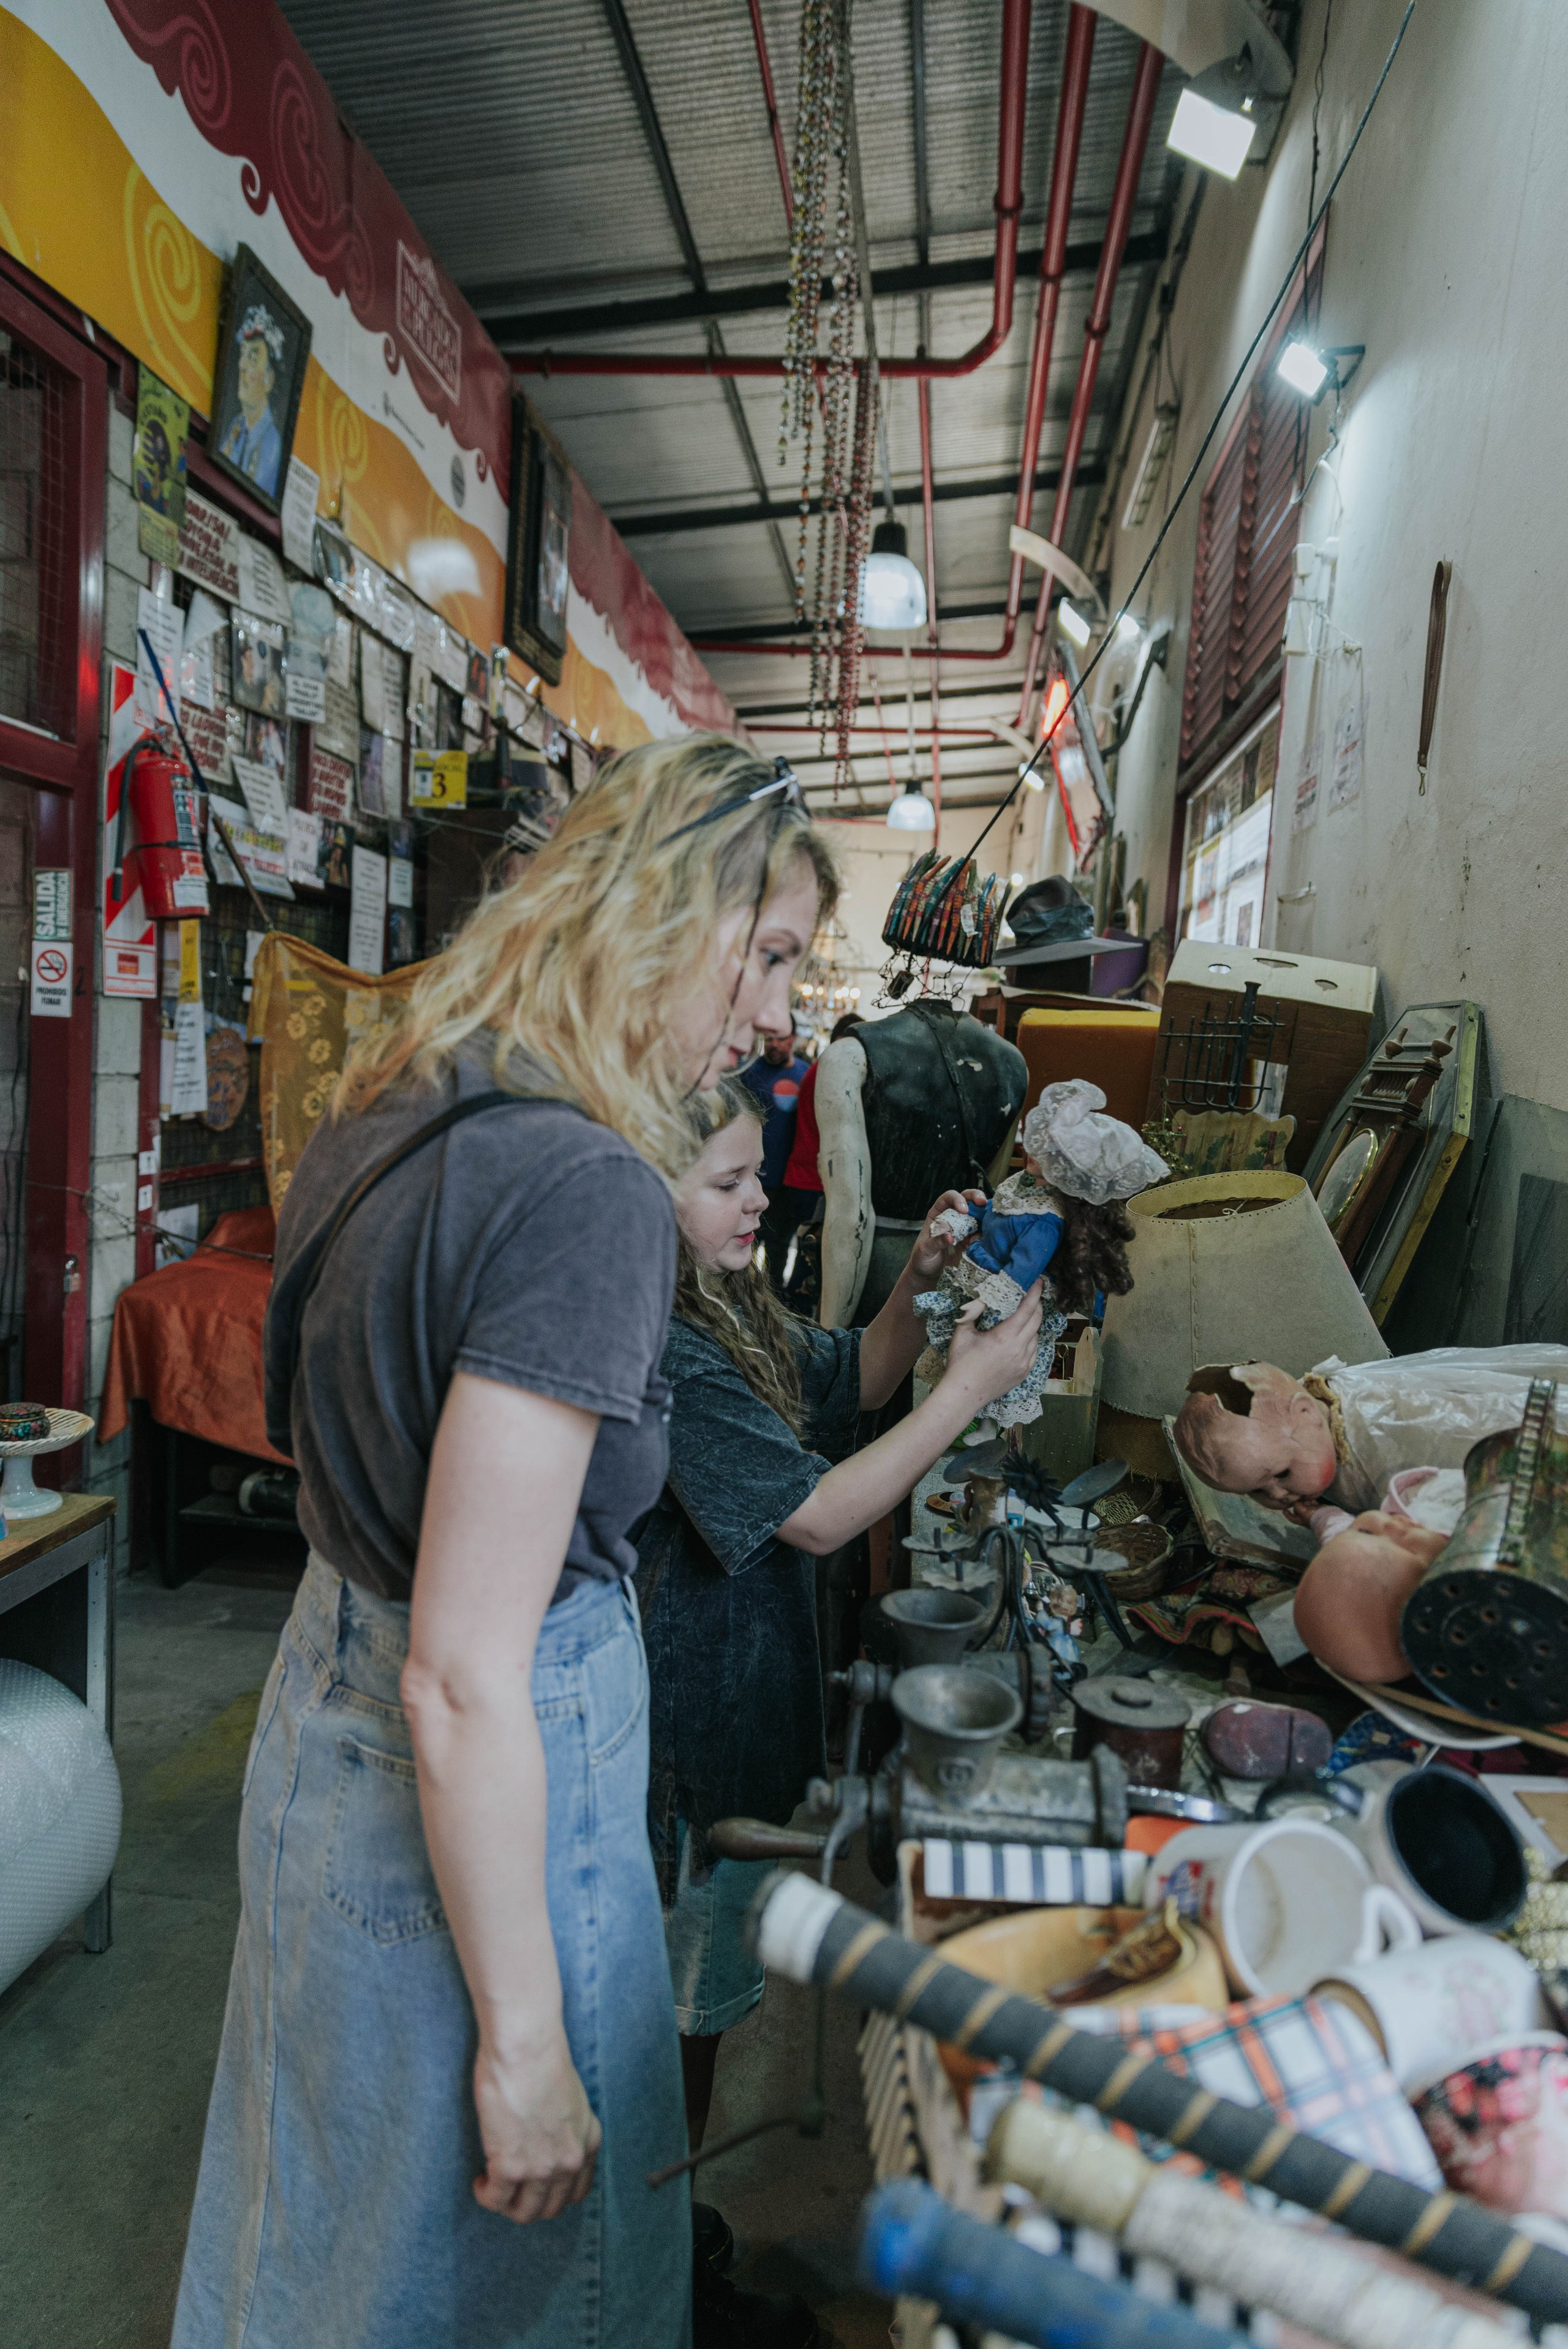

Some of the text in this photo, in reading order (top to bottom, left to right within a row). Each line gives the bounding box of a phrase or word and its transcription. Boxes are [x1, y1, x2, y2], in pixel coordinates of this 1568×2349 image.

[36, 871, 55, 937] SALIDA
[56, 871, 69, 926] EMERGENCIA
[36, 986, 67, 996] PROHIBIDO
[41, 997, 61, 1006] FUMAR
